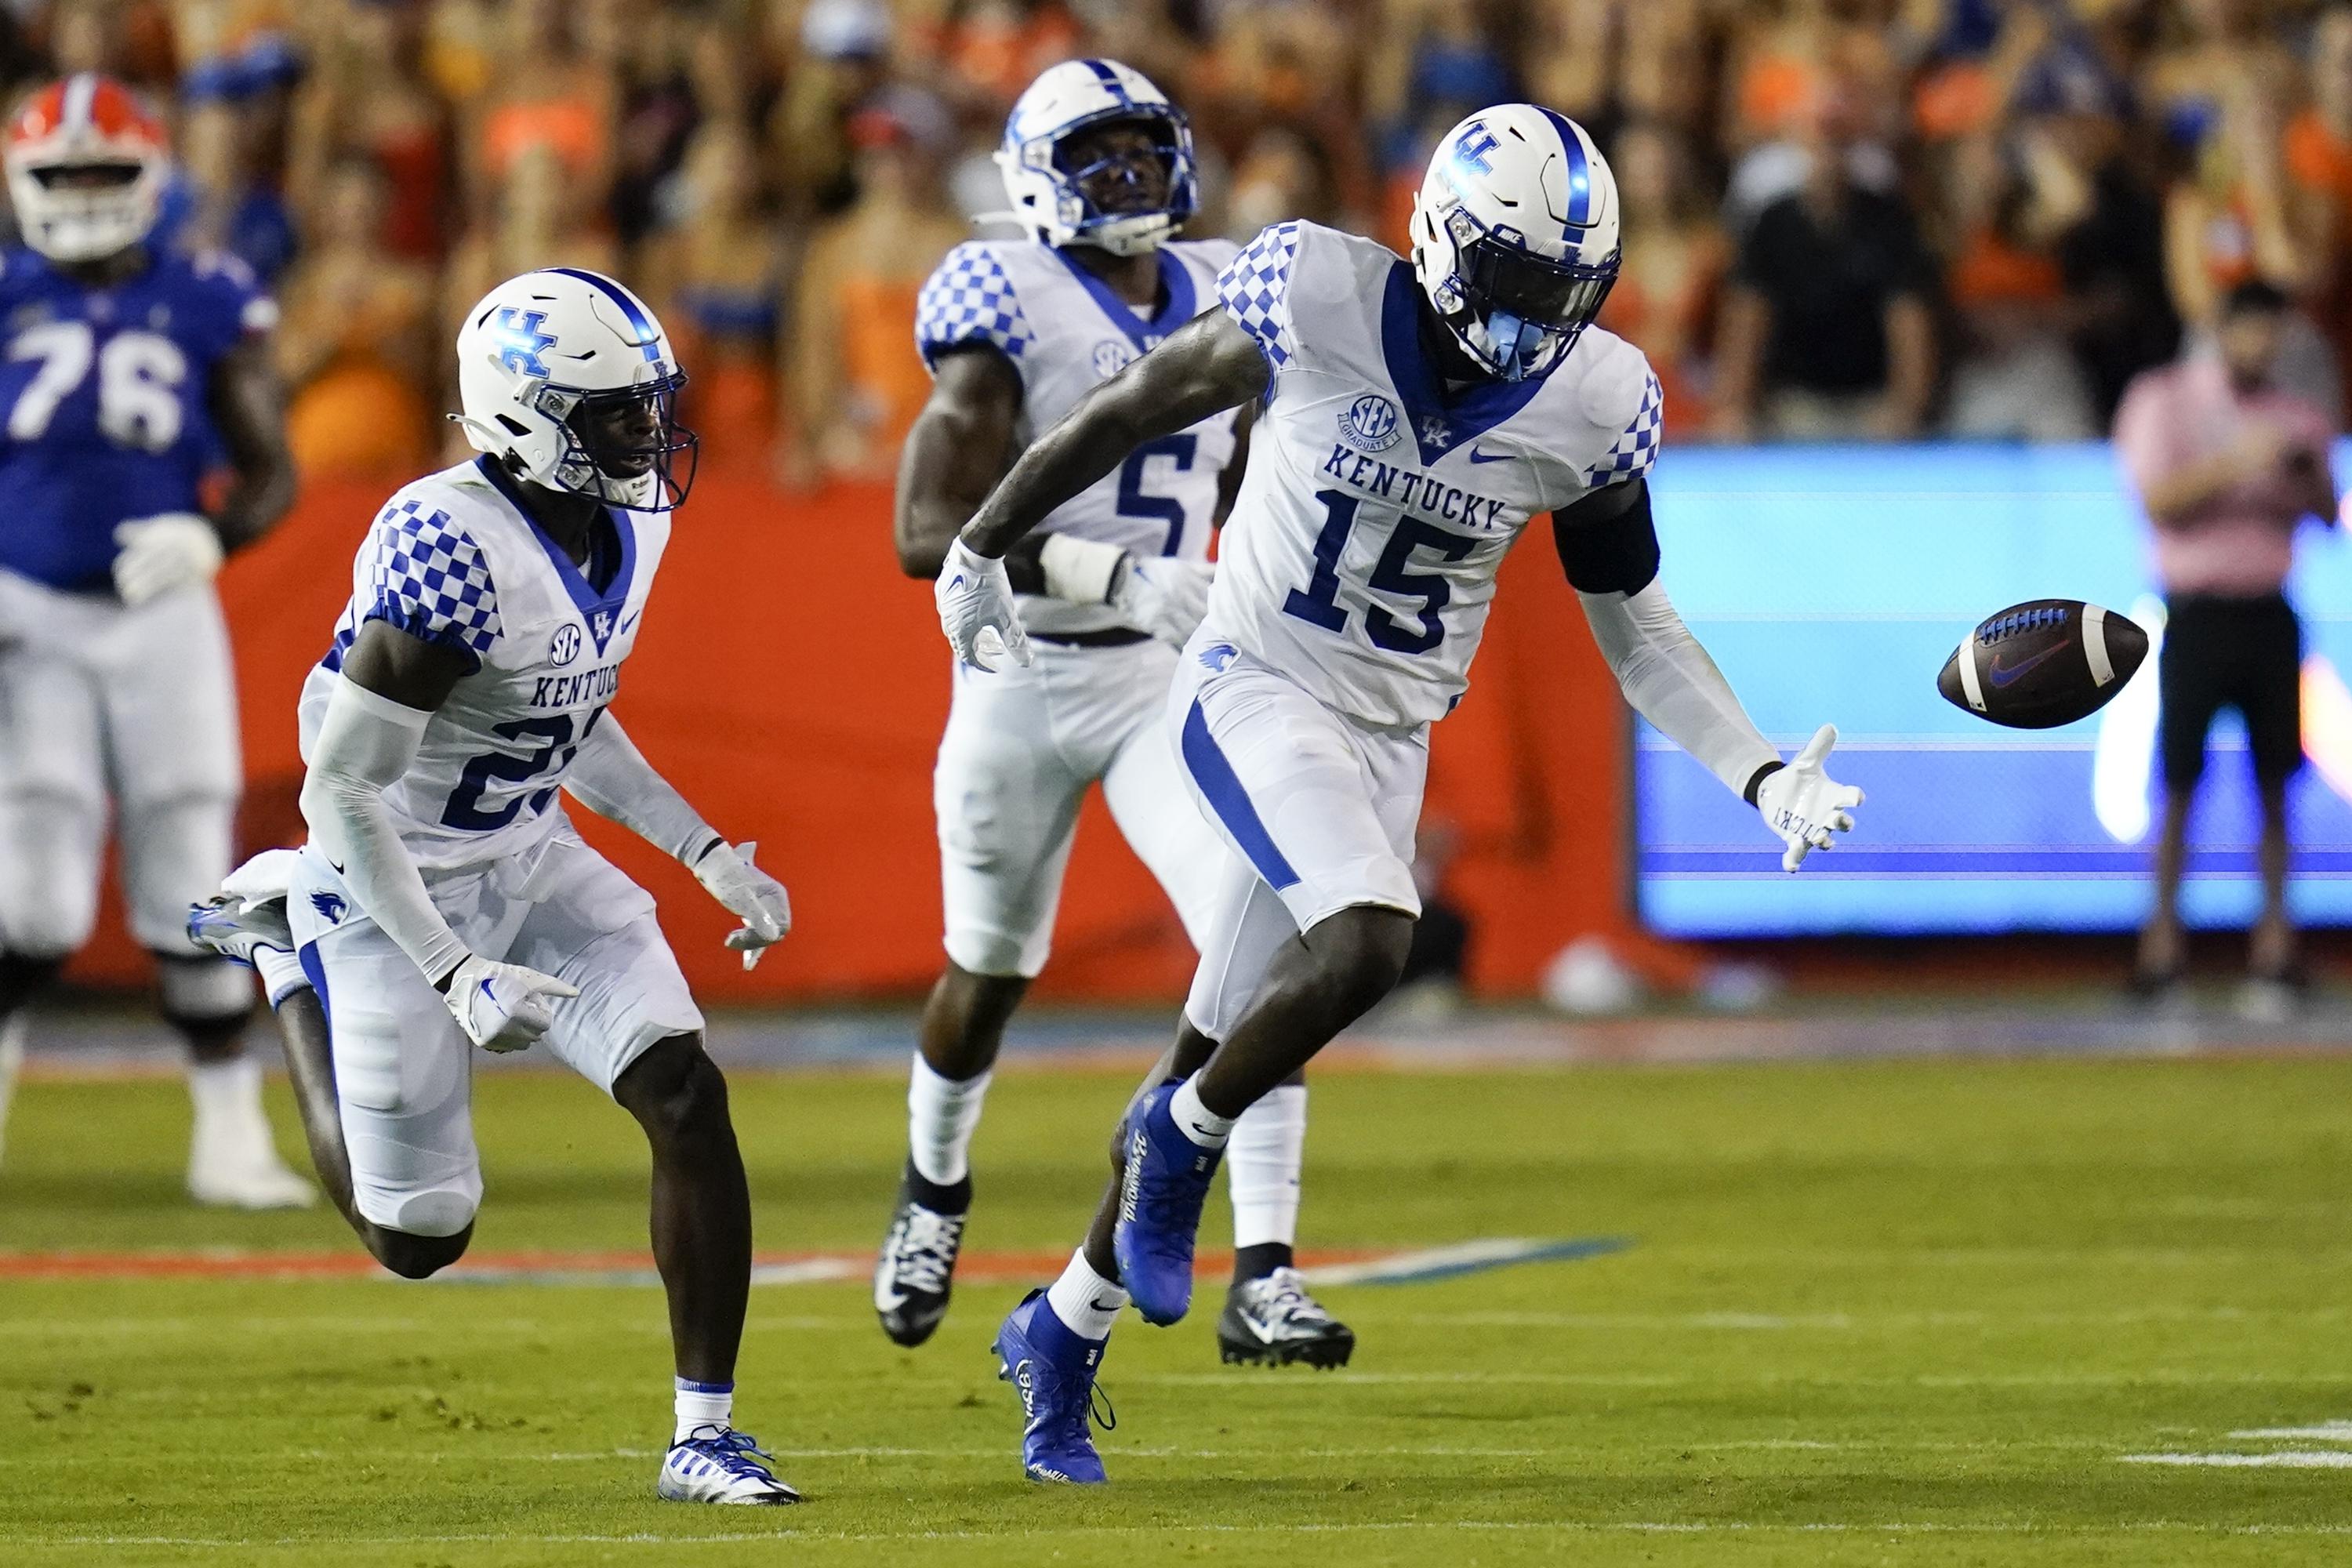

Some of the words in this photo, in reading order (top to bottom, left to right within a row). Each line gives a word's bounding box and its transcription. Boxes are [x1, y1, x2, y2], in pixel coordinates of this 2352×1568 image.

[6, 322, 187, 456] 76
[1352, 397, 1395, 437] SEC
[1341, 423, 1390, 451] GRADUATE
[1116, 434, 1197, 557] 5
[1323, 443, 1505, 530] KENTUCKY
[1283, 488, 1484, 655] 15
[550, 624, 581, 666] SEC
